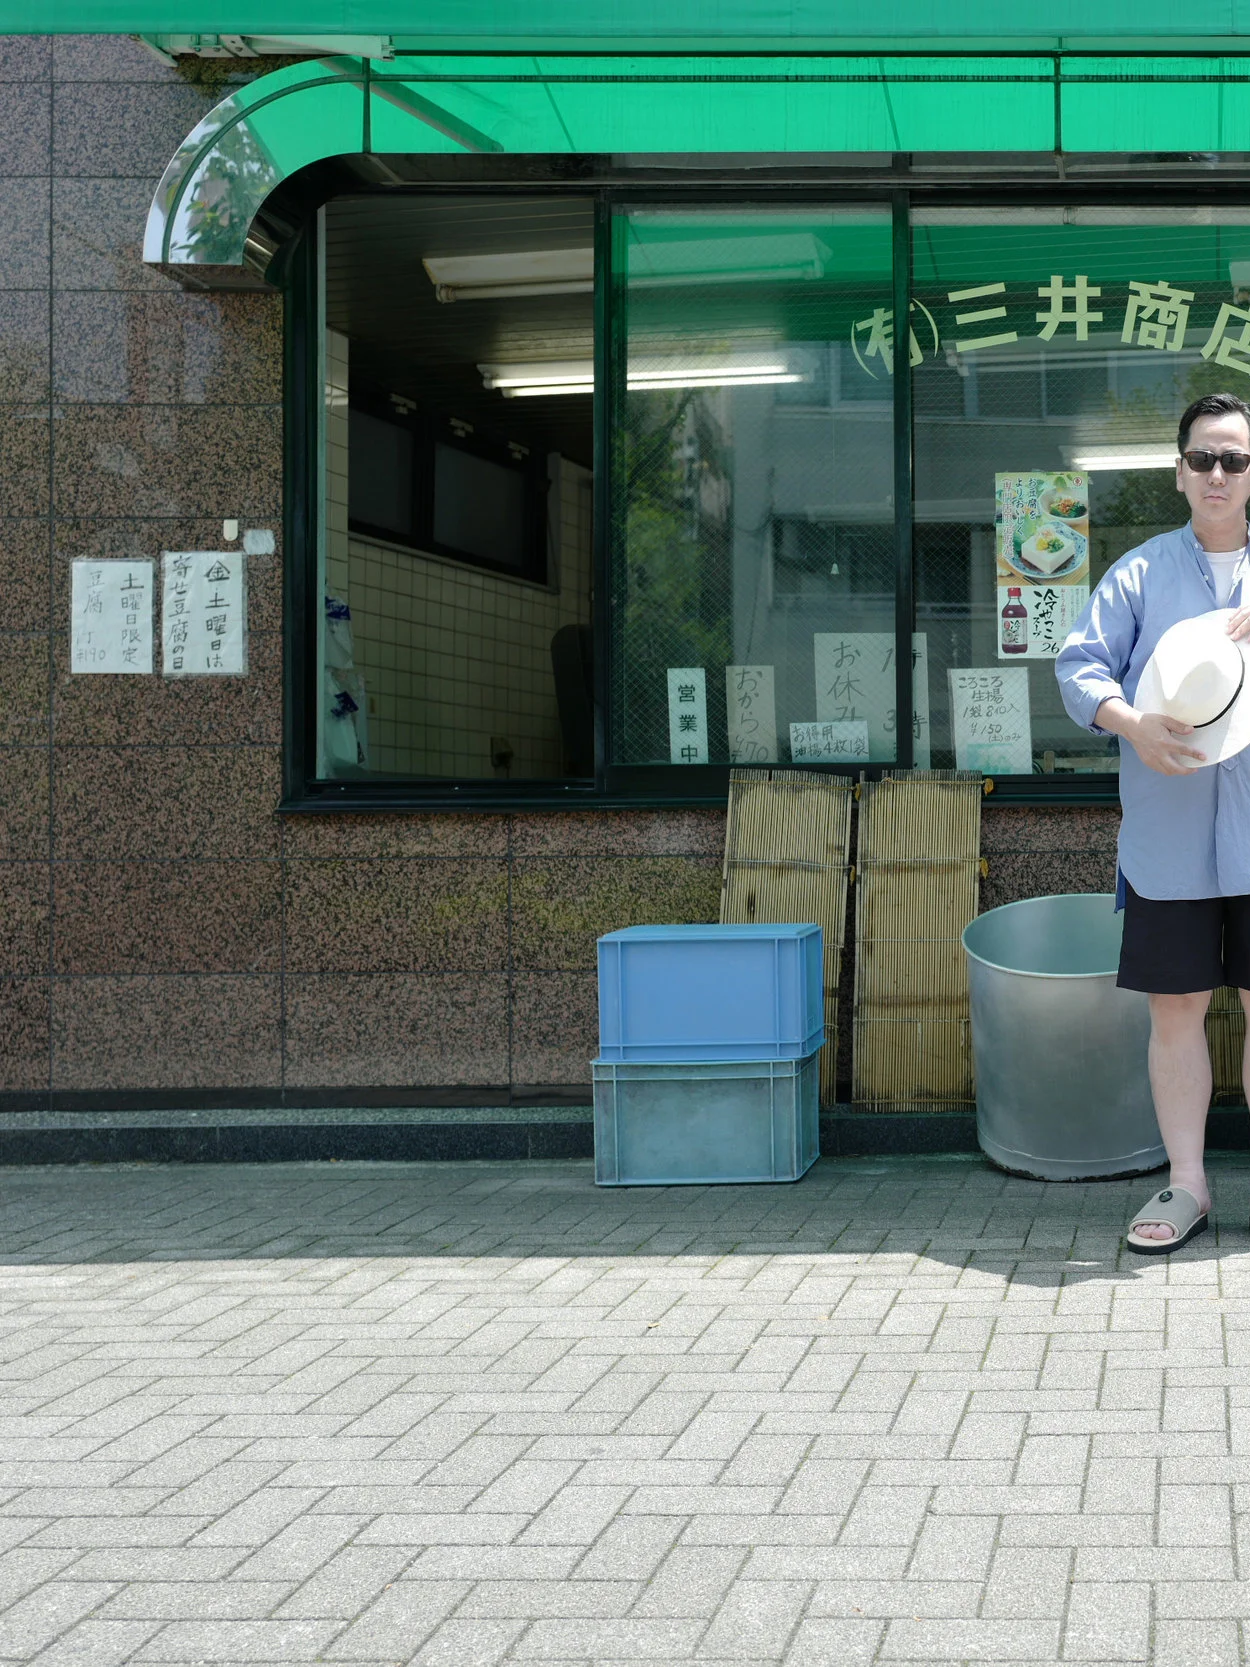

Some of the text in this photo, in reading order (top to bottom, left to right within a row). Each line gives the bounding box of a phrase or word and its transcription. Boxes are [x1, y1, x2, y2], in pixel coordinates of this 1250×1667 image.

[1014, 477, 1025, 536] よりおいしく
[1028, 477, 1038, 520] お豆腐を
[83, 570, 106, 614] 豆腐
[165, 554, 193, 670] 寄せ豆腐の日
[120, 572, 145, 666] 土曜日限定
[1032, 617, 1043, 639] スープ
[1033, 588, 1060, 640] 冷やっこ
[735, 667, 763, 734] おから
[826, 640, 866, 722] お休み
[958, 676, 1004, 689] ころころ
[972, 688, 1004, 704] 生揚
[678, 684, 698, 763] 営業中
[792, 724, 834, 743] お得用
[971, 722, 1002, 737] ¥150
[731, 735, 769, 763] ¥70
[794, 736, 869, 758] 油揚4枚1袋
